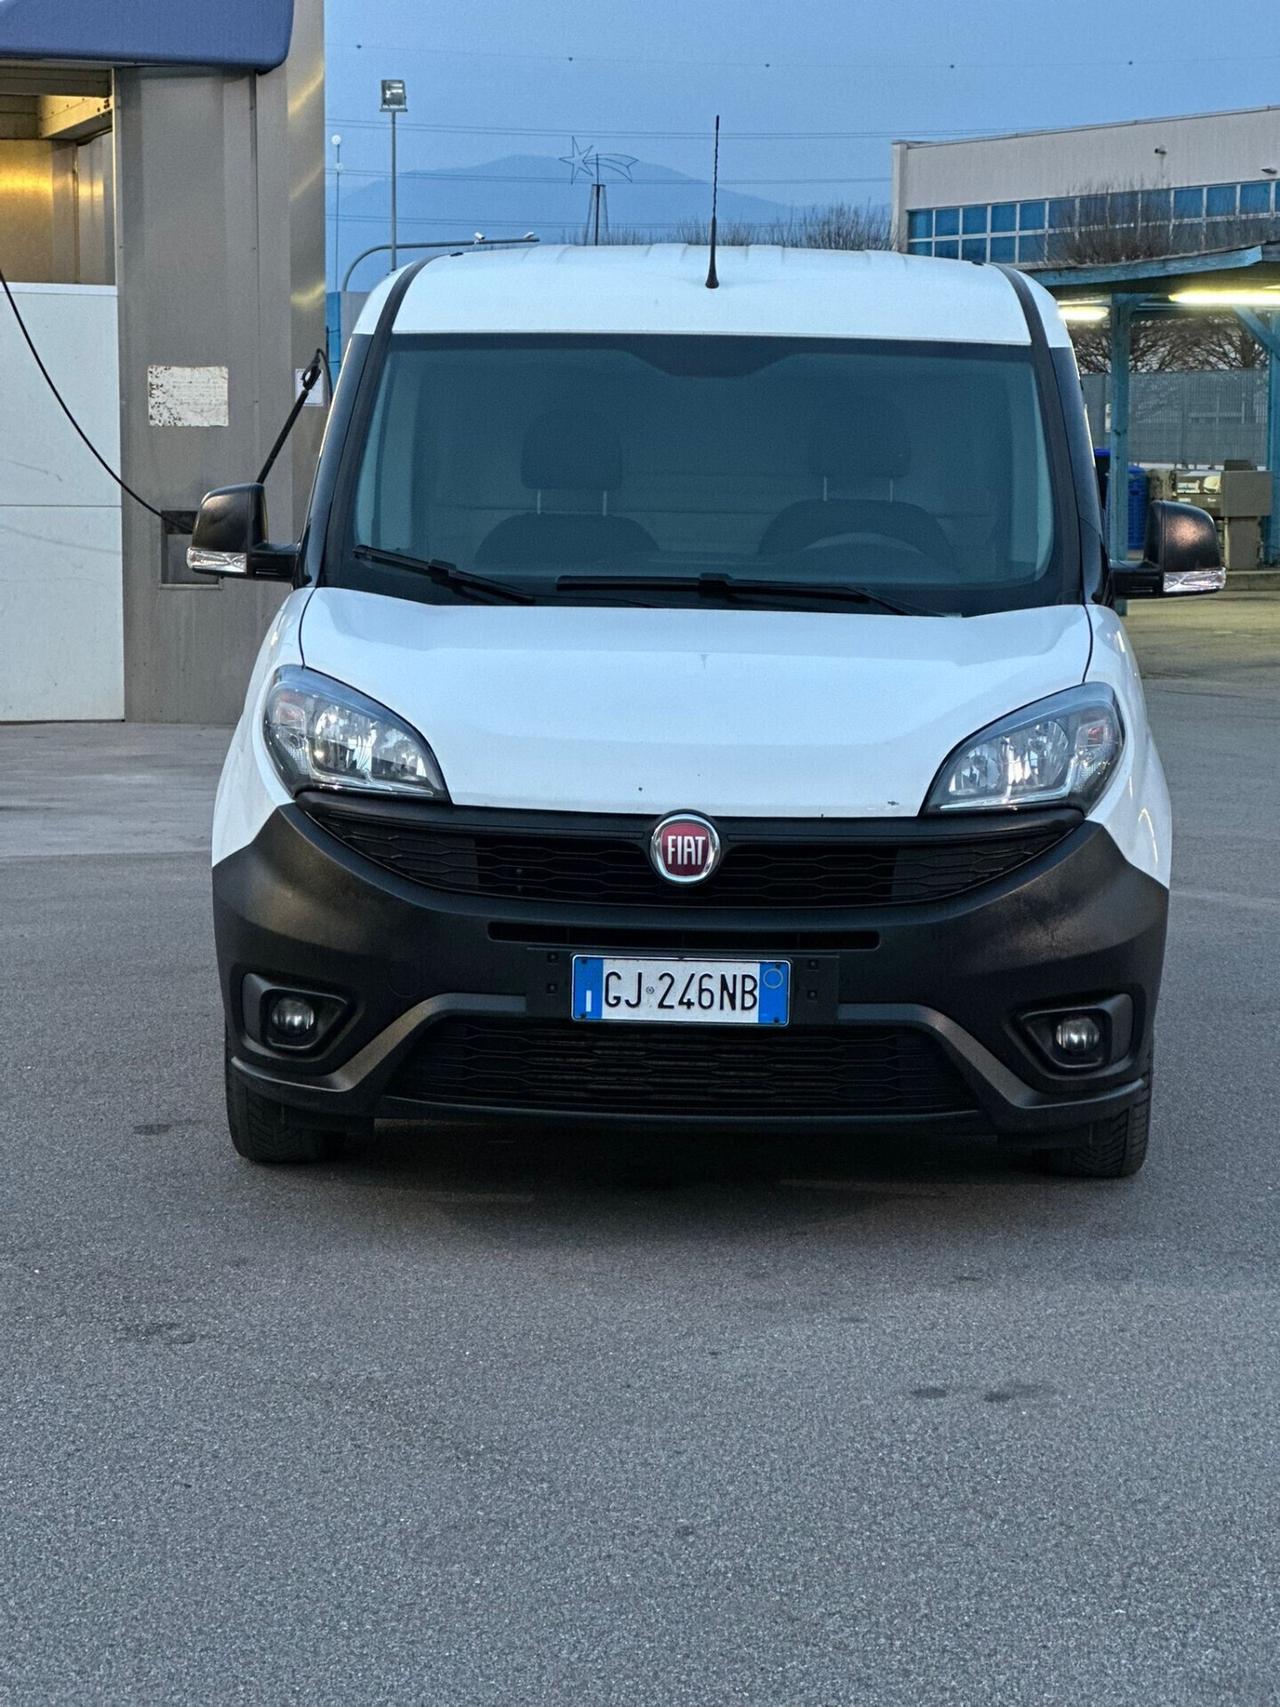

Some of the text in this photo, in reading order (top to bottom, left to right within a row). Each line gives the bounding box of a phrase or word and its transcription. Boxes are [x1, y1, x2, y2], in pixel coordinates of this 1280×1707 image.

[667, 835, 706, 865] FIAT
[604, 971, 643, 1008] GJ
[657, 972, 758, 1011] 246NB
